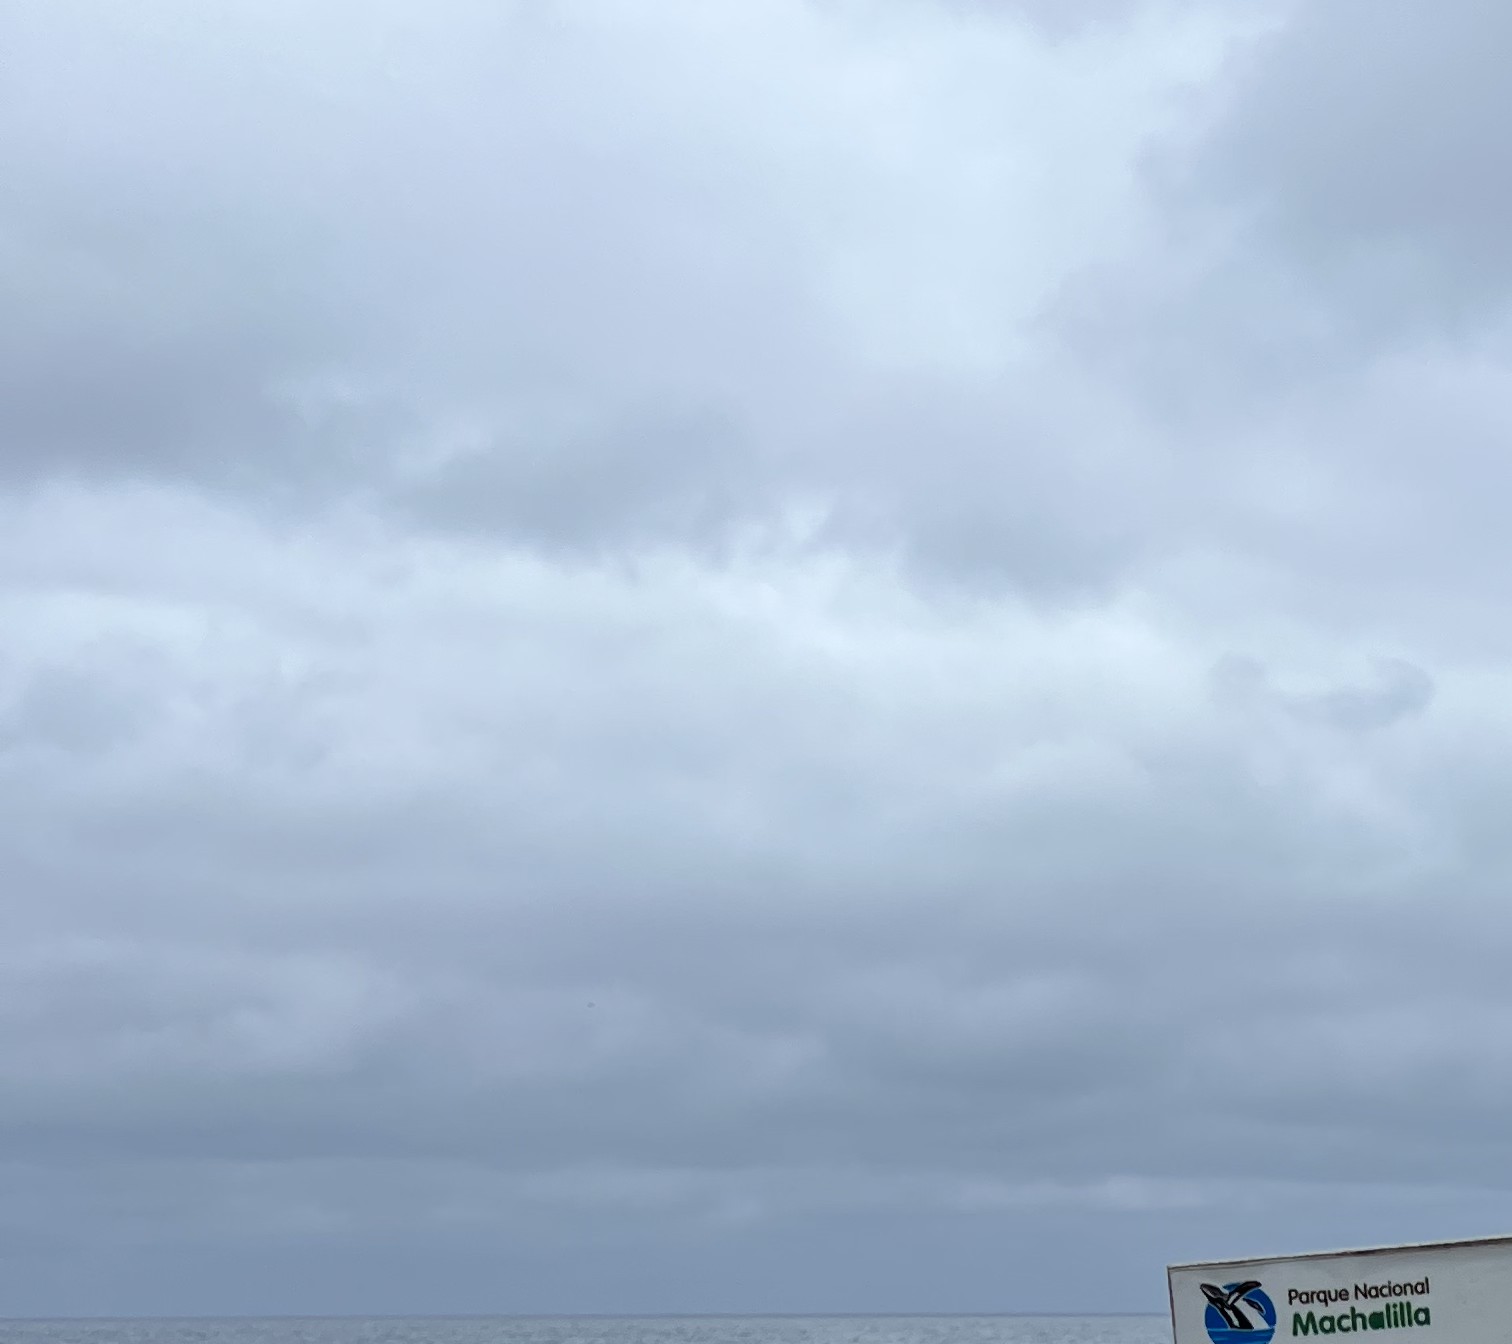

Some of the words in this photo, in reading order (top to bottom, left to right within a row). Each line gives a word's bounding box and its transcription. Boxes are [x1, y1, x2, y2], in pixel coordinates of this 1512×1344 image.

[1288, 1287, 1350, 1307] Parque
[1353, 1276, 1430, 1301] Nacional
[1291, 1301, 1431, 1337] Machalilla
